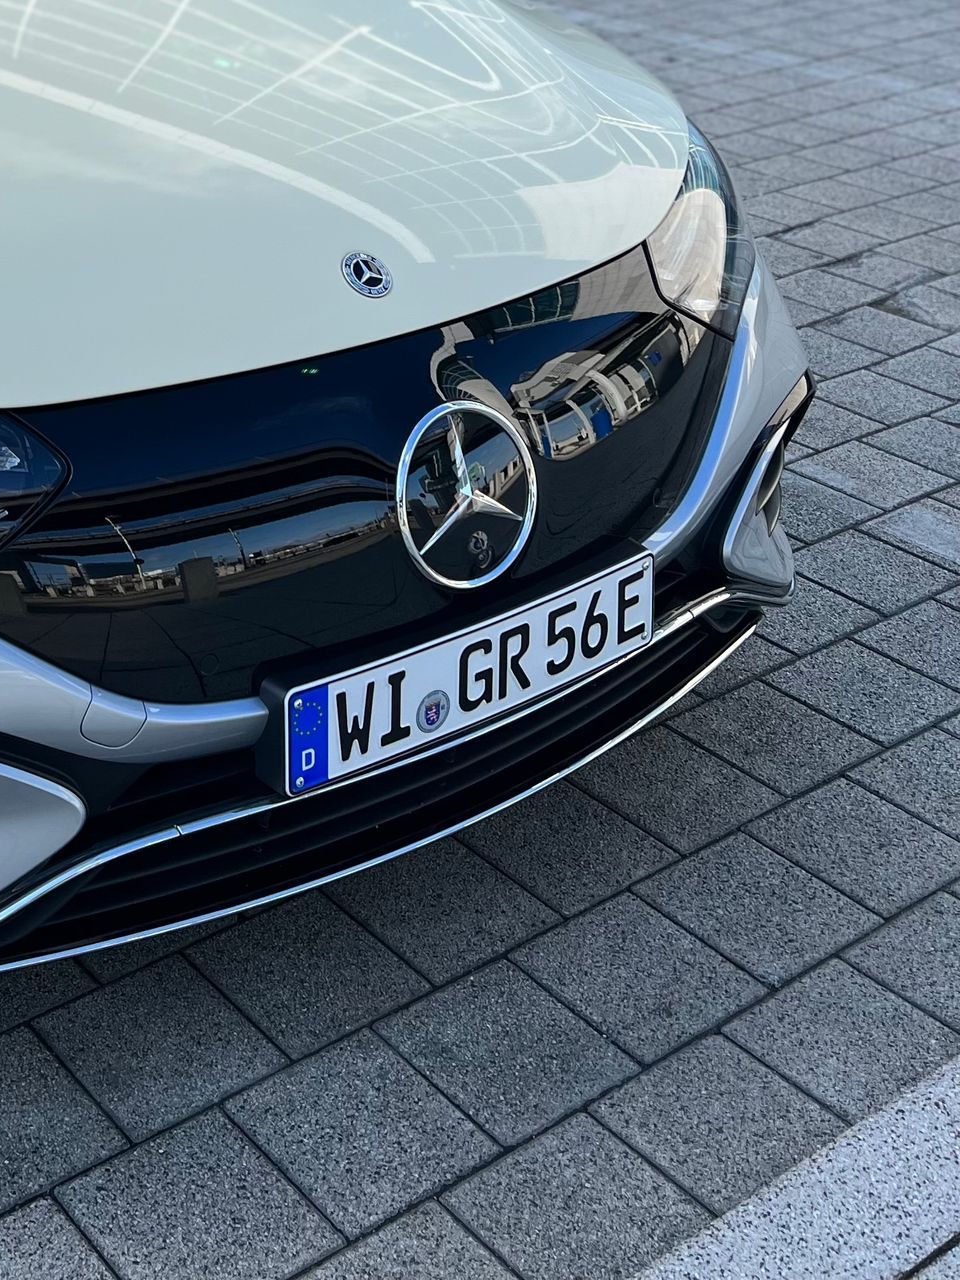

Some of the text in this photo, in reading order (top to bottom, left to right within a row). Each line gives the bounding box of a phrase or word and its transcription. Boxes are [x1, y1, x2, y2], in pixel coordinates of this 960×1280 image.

[336, 669, 411, 762] WI
[458, 622, 531, 712] GR
[546, 570, 645, 676] 56E
[301, 748, 315, 771] D
